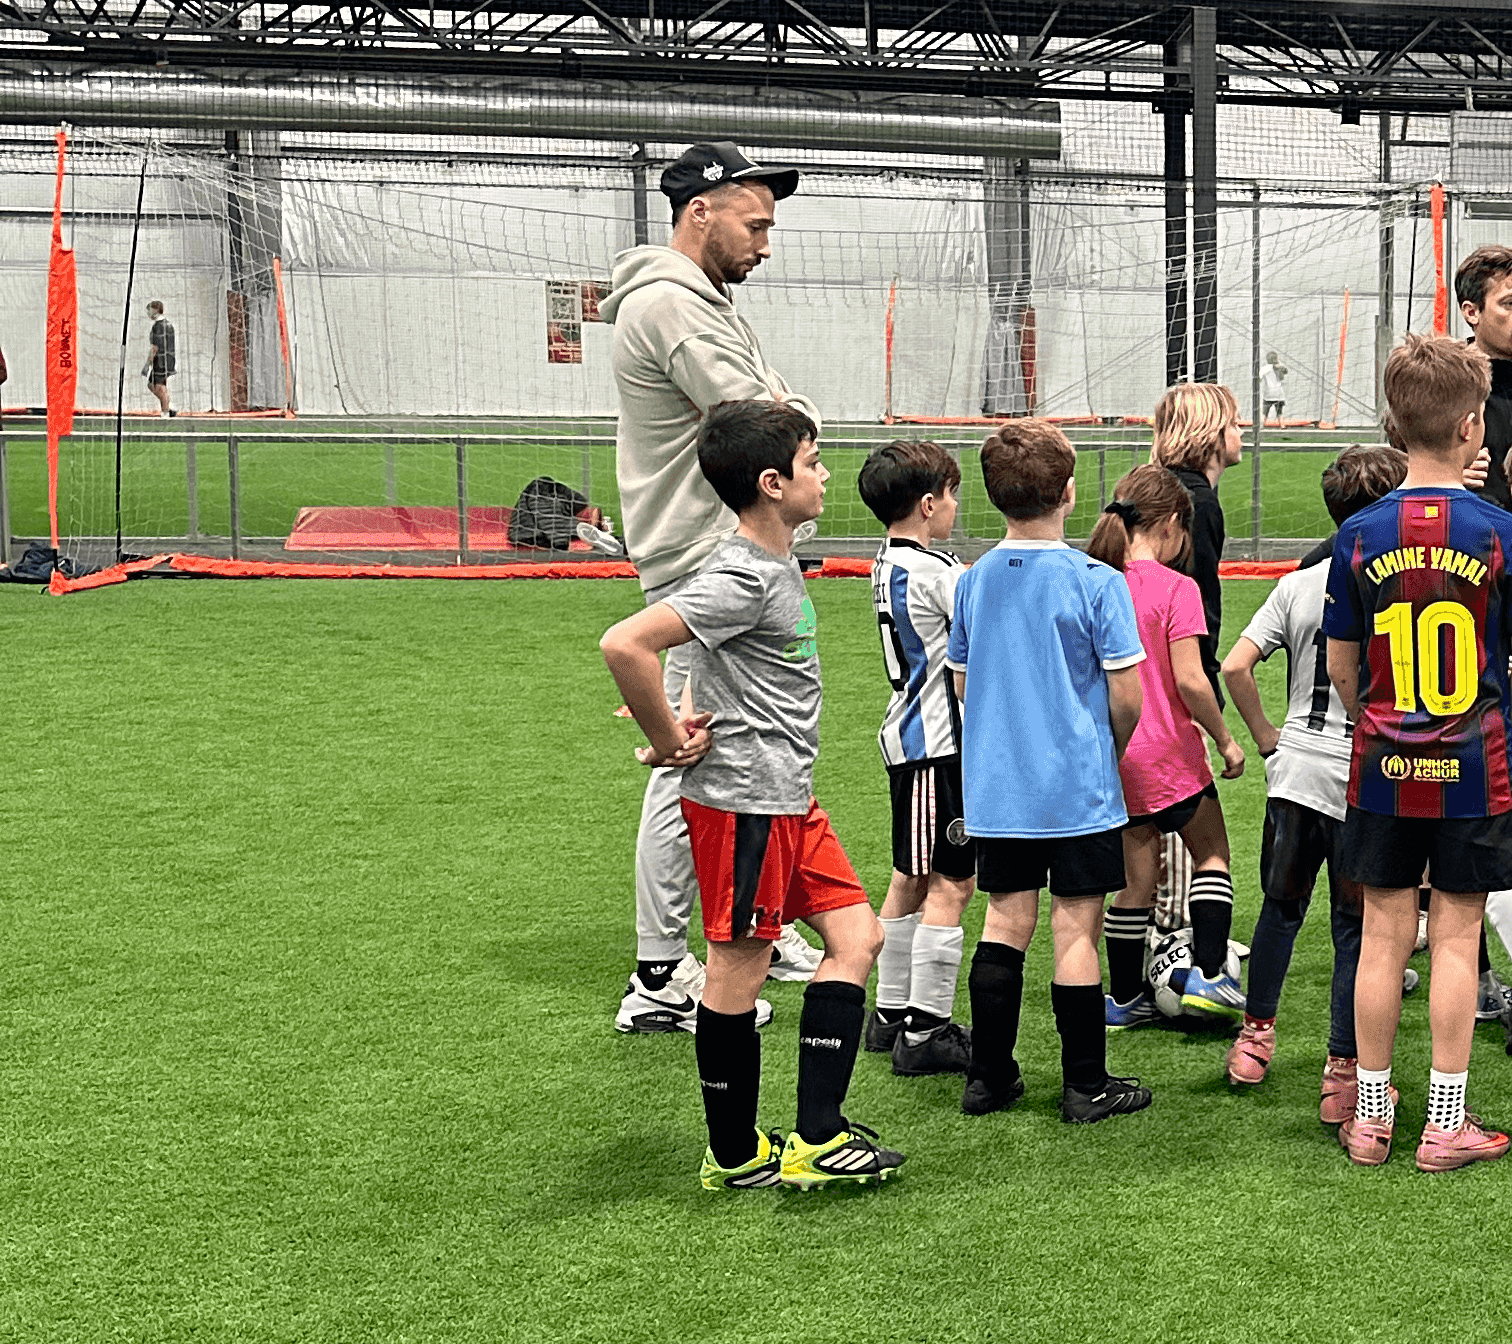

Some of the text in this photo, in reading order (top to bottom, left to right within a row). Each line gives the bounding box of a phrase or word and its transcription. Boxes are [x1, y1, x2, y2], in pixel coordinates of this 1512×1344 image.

[1365, 546, 1488, 586] LAMINE YAMAL
[1374, 601, 1479, 717] 10
[1413, 758, 1460, 768] UNHCR
[1413, 767, 1460, 778] ACNUR
